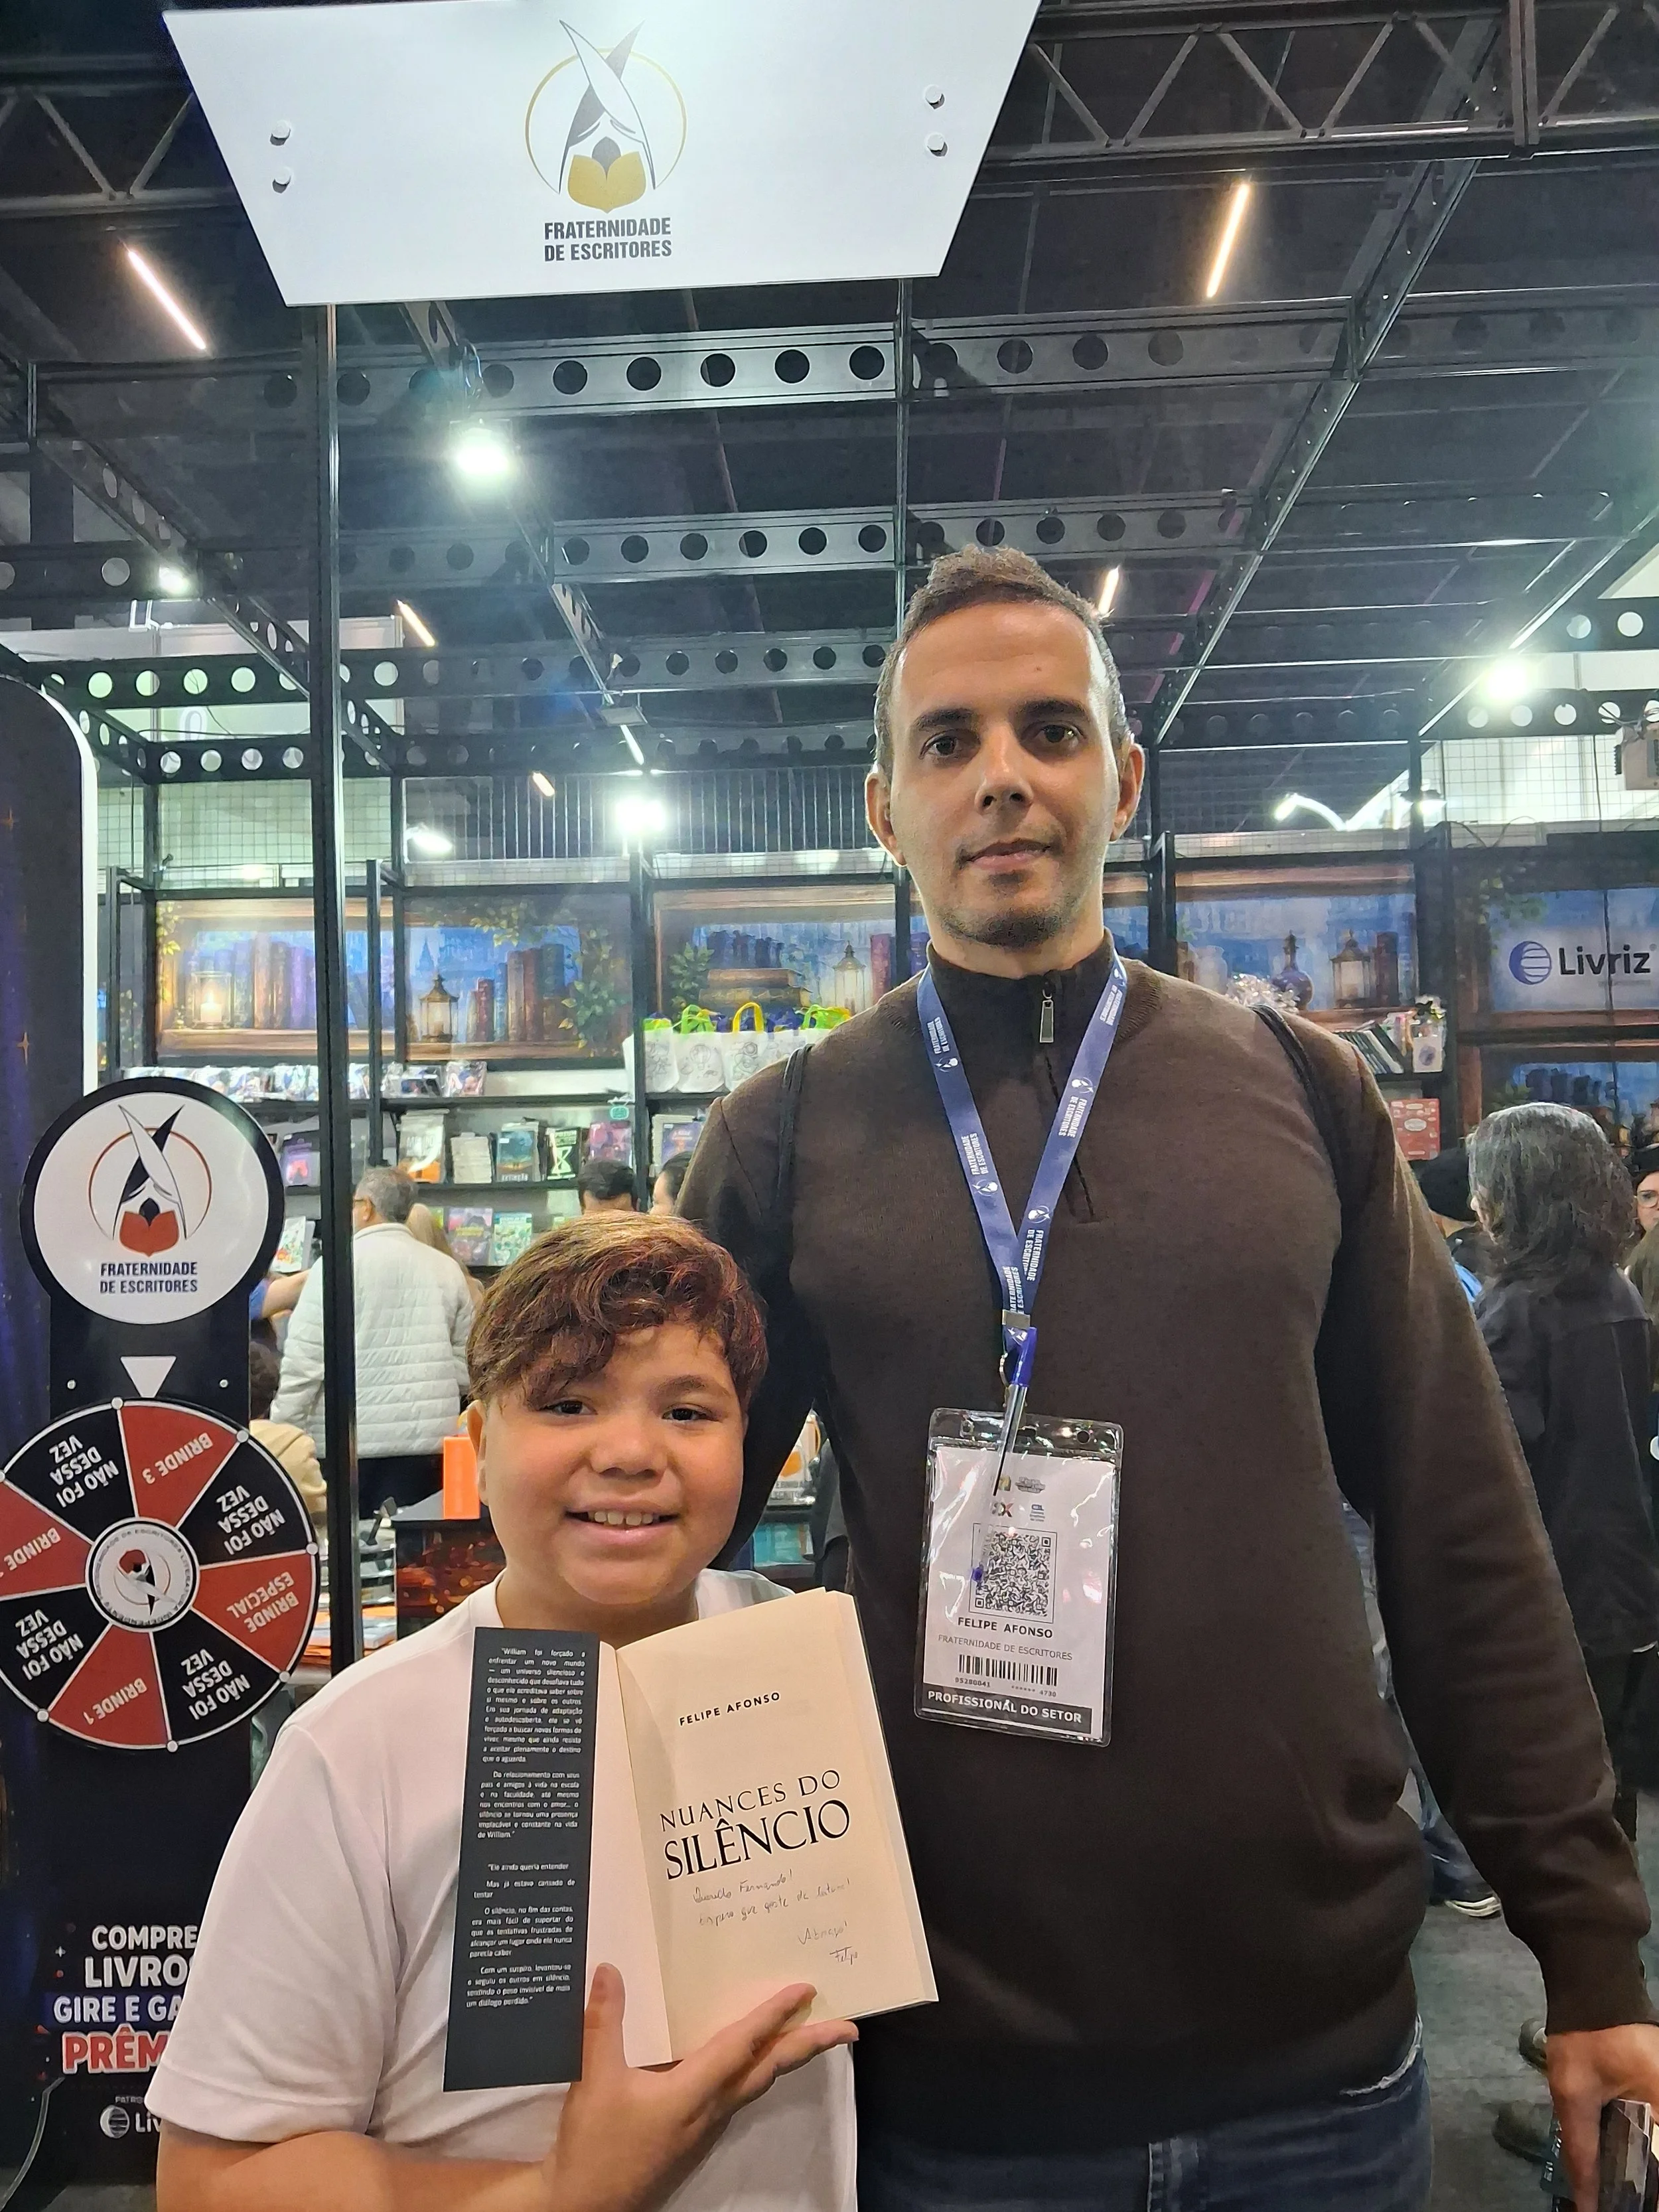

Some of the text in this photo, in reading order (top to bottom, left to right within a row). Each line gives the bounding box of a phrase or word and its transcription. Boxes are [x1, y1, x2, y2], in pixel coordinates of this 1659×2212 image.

[545, 217, 671, 240] FRATERNIDADE
[545, 240, 672, 262] DE ESCRITORES
[1559, 944, 1650, 975] Livriz
[1058, 1104, 1076, 1136] ESCRITORES
[1067, 1099, 1087, 1138] FRATERNIDADE
[961, 1135, 980, 1175] FRATERNIDADE
[970, 1133, 986, 1165] ESCRITORES
[100, 1262, 198, 1277] FRATERNIDADE
[1027, 1230, 1044, 1281] FRATERNIDADE
[100, 1280, 198, 1294] DE ESCRITORES
[1003, 1266, 1016, 1313] RATERNIDADE
[49, 1435, 83, 1463] VEZ
[50, 1446, 102, 1485] DESSA
[143, 1432, 213, 1484] BRINDE 3
[56, 1460, 119, 1508] NÃO FOI
[216, 1485, 250, 1512] VEZ
[218, 1496, 269, 1533] DESSA
[224, 1509, 286, 1555] NÃO FOI
[4, 1527, 61, 1571] BRINDE
[226, 1571, 295, 1618] ESPECIAL
[244, 1591, 299, 1633] BRINDE
[15, 1609, 49, 1637] VEZ
[16, 1620, 66, 1659] DESSA
[958, 1617, 1052, 1638] FELIPE AFONSO
[22, 1633, 84, 1680] NÃO FOI
[180, 1649, 214, 1676] VEZ
[938, 1635, 1001, 1650] FRATERNIDADE
[1019, 1647, 1072, 1660] ESCRITORES
[182, 1660, 232, 1698] DESSA
[188, 1674, 251, 1720] NÃO FOI
[83, 1678, 147, 1725] BRINDE 1
[679, 1692, 780, 1726] FELIPE AFONSO
[928, 1690, 1082, 1724] PROFISSIONAL DO SETOR
[660, 1769, 840, 1832] NUANCES DO
[664, 1799, 850, 1880] SILÊNCIO
[92, 1925, 198, 1950] COMPRE
[84, 1956, 196, 1988] LIVRO
[54, 1996, 116, 2023] GIRE
[125, 1996, 140, 2022] E
